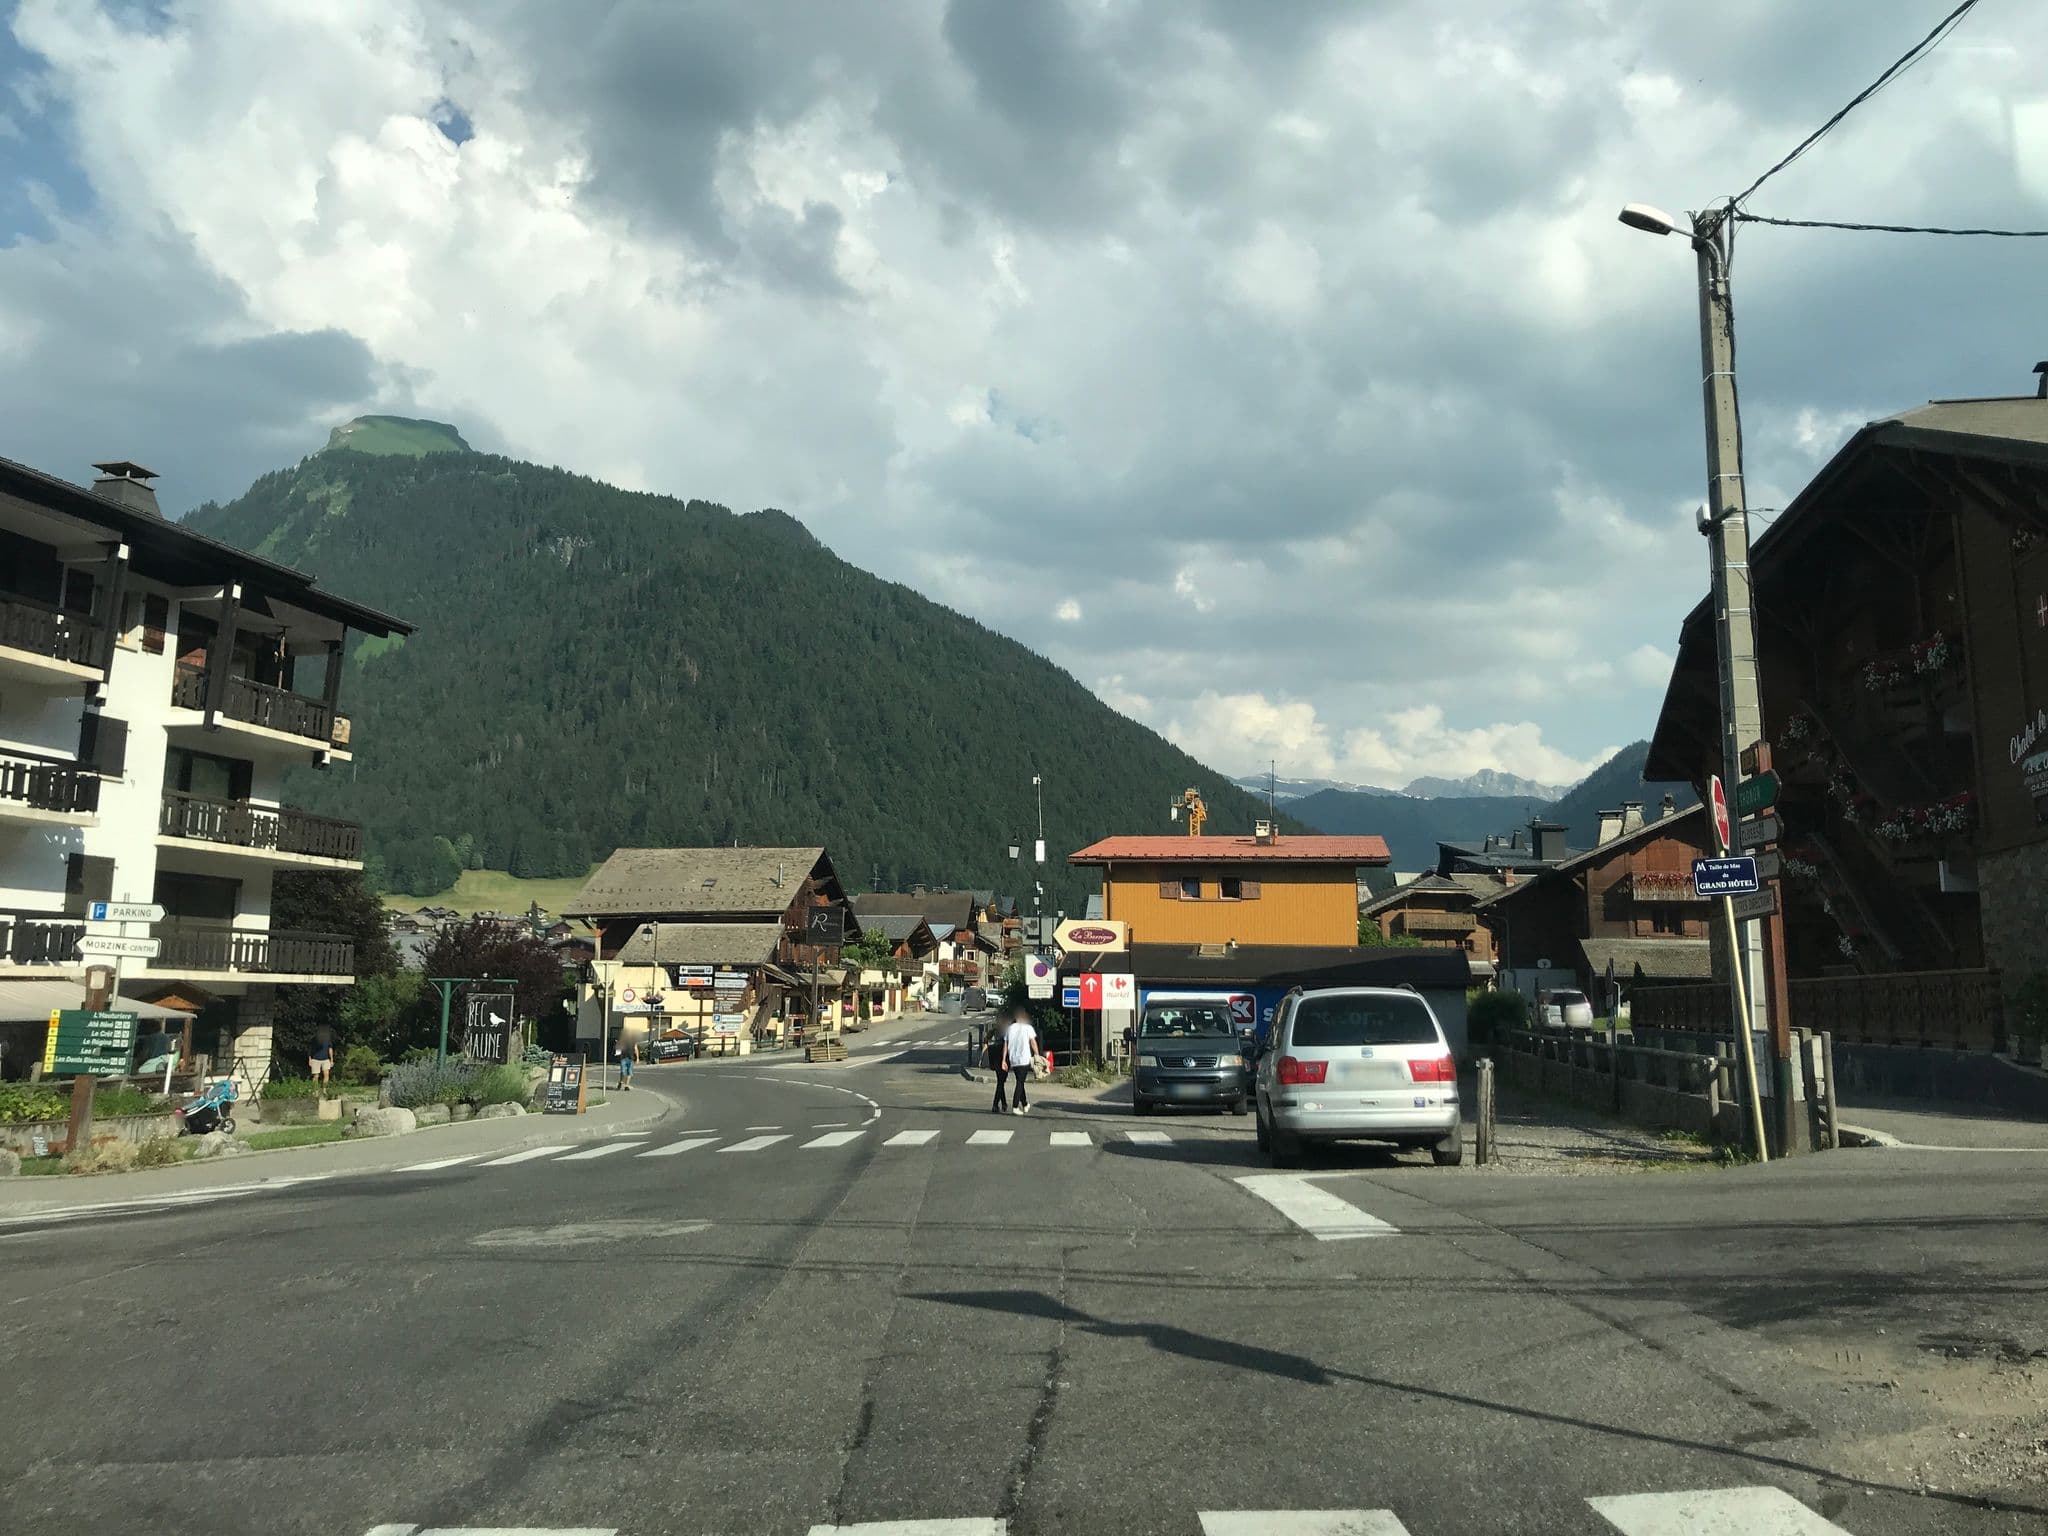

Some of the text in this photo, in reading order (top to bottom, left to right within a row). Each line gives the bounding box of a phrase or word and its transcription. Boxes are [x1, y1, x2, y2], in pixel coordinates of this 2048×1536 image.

[1715, 802, 1728, 824] STOP
[1699, 879, 1755, 890] GRAND HÔTEL
[113, 908, 152, 917] PARKING
[85, 940, 127, 951] MORZINE
[468, 1001, 488, 1027] BEC
[467, 1033, 502, 1059] JAUNE
